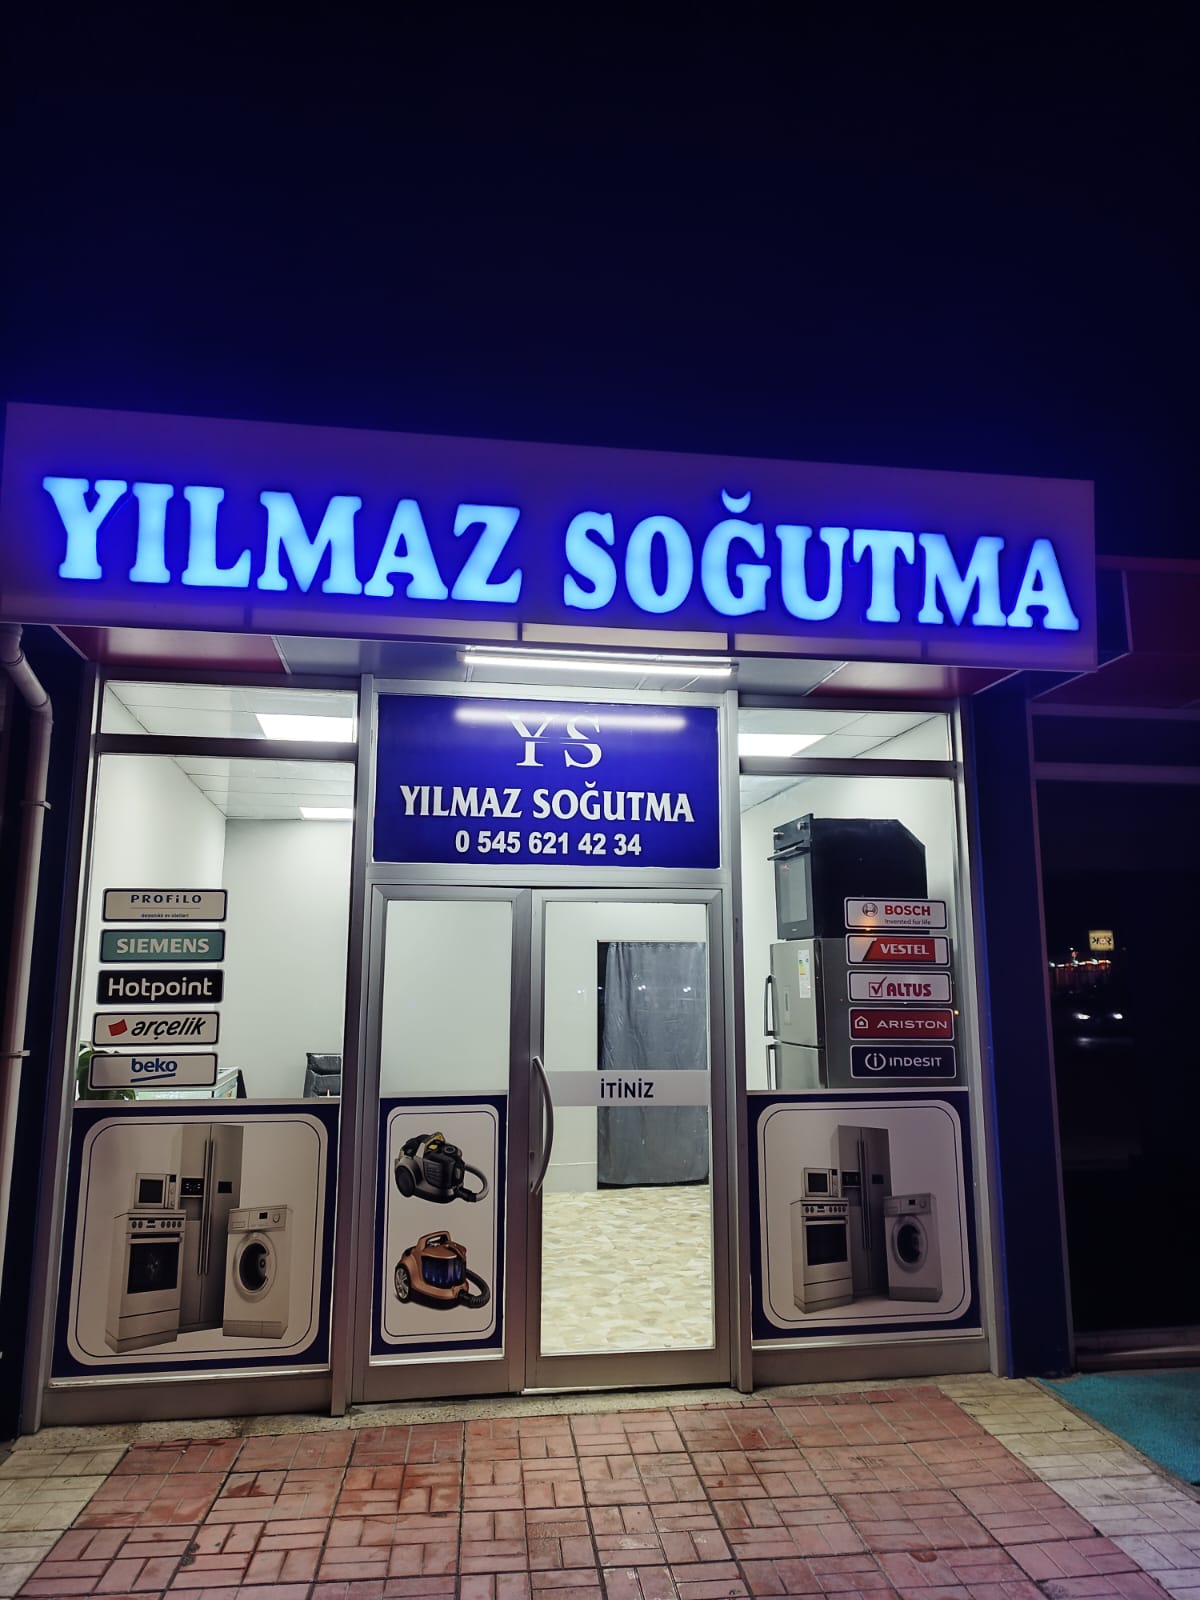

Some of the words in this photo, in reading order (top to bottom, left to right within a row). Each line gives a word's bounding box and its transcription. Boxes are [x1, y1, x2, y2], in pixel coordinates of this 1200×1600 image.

[43, 476, 523, 604] YILMAZ
[563, 490, 1080, 632] SOĞUTMA
[505, 713, 602, 769] YS
[400, 785, 522, 819] YILMAZ
[533, 781, 695, 823] SOĞUTMA
[455, 830, 470, 853] 0
[477, 831, 521, 854] 545
[528, 832, 569, 855] 621
[578, 833, 606, 855] 42
[613, 834, 642, 856] 34
[884, 905, 931, 916] BOSCH
[116, 938, 210, 954] SIEMENS
[880, 943, 930, 955] VESTEL
[108, 977, 213, 1001] Hotpoint
[886, 983, 932, 997] ALTUS
[131, 1017, 206, 1040] arçelik
[877, 1020, 948, 1029] ARISTON
[131, 1058, 178, 1073] beko
[600, 1078, 655, 1099] İTİNİZ
